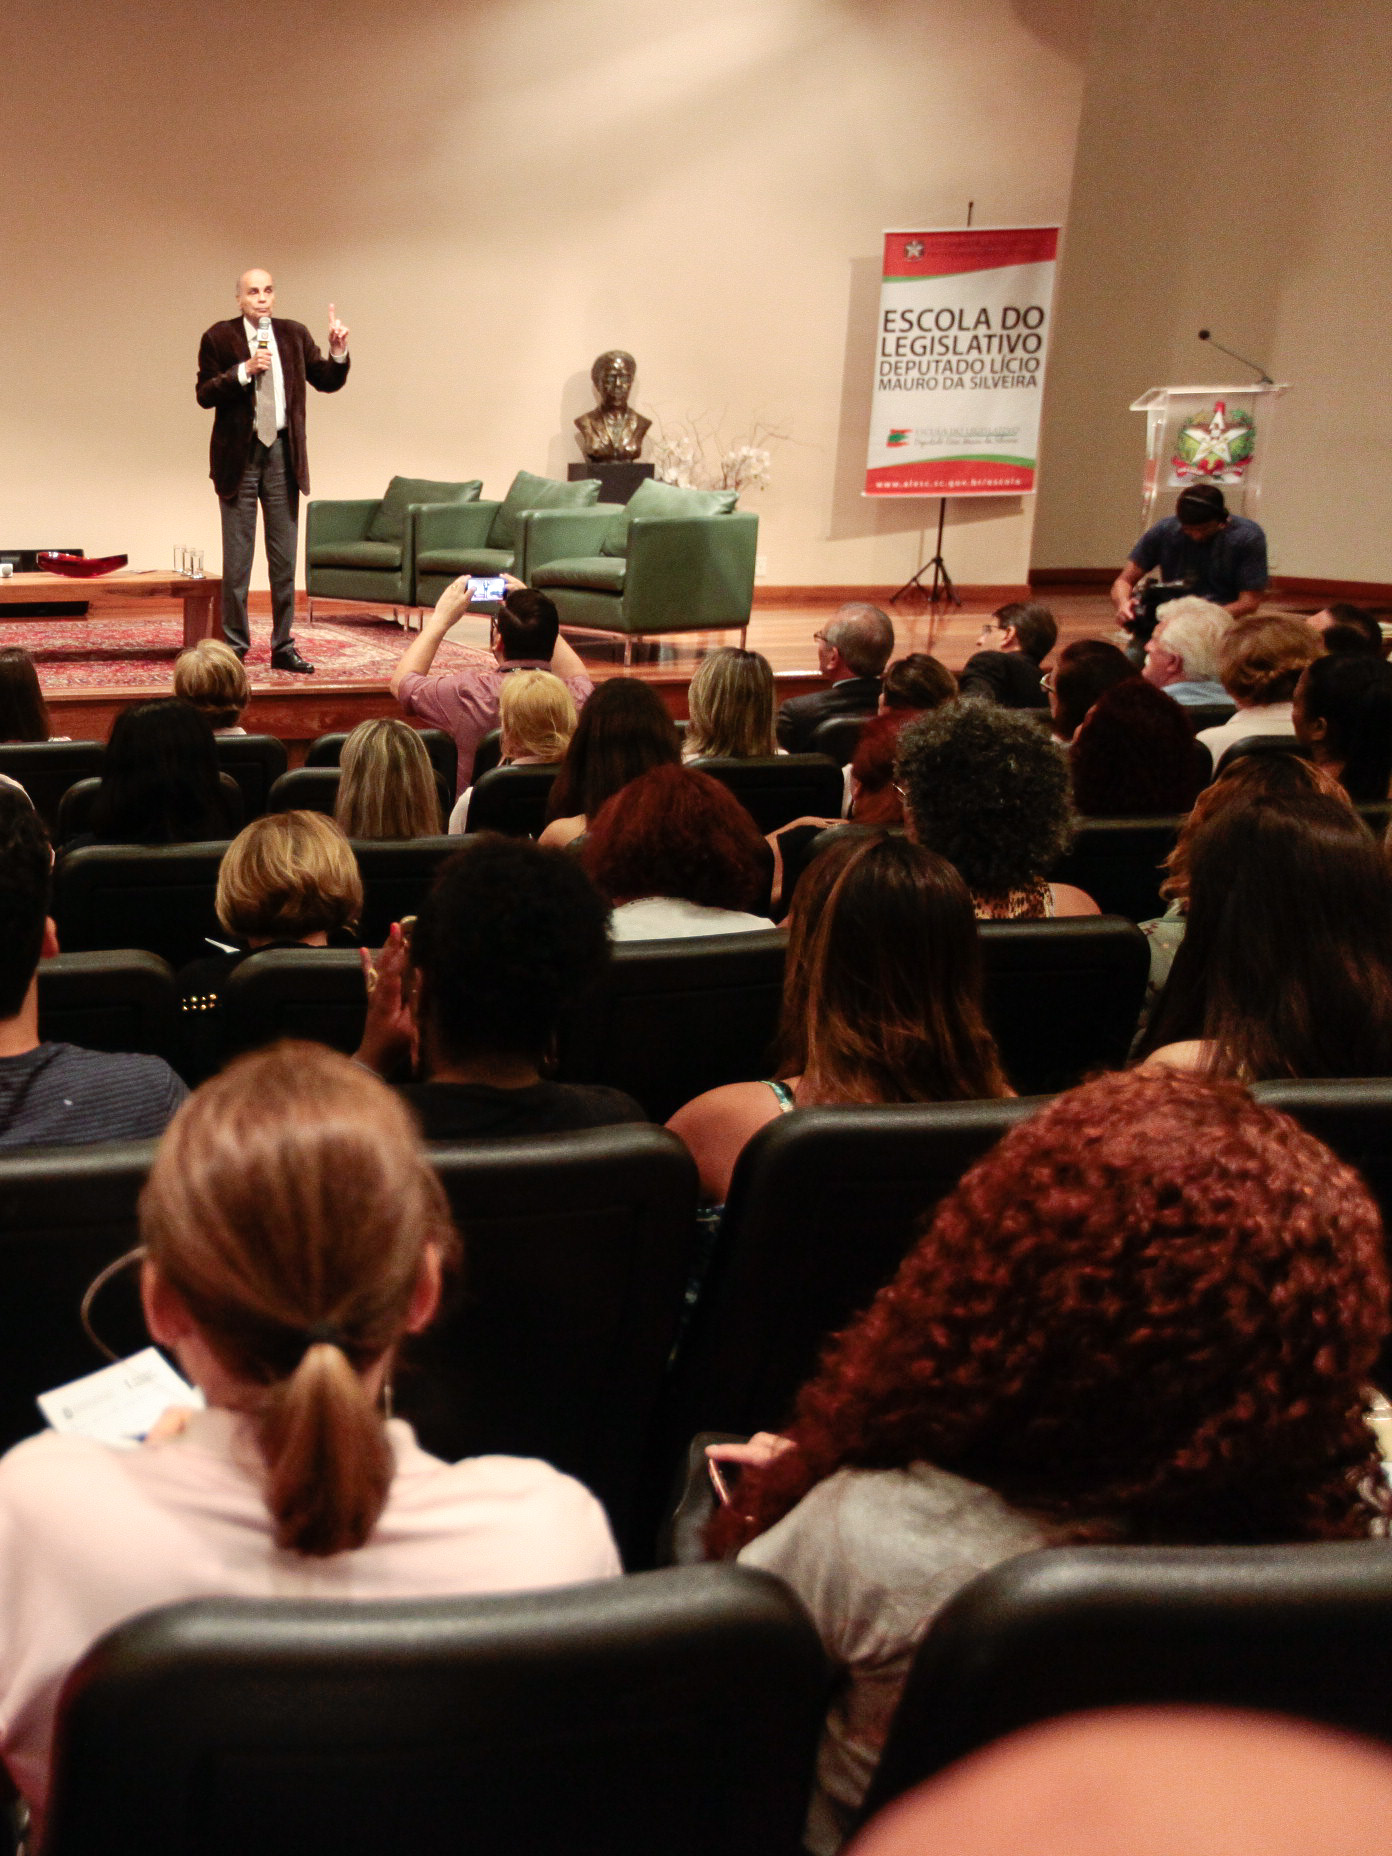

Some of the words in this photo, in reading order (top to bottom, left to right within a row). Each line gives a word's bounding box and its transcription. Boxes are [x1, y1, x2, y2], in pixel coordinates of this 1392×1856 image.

[883, 307, 991, 333] ESCOLA
[1001, 306, 1045, 330] DO
[881, 333, 1043, 357] LEGISLATIVO
[879, 358, 985, 377] DEPUTADO
[989, 353, 1041, 374] LÍCIO
[878, 377, 939, 391] MAURO
[942, 377, 965, 390] DA
[969, 375, 1038, 390] SILVEIRA
